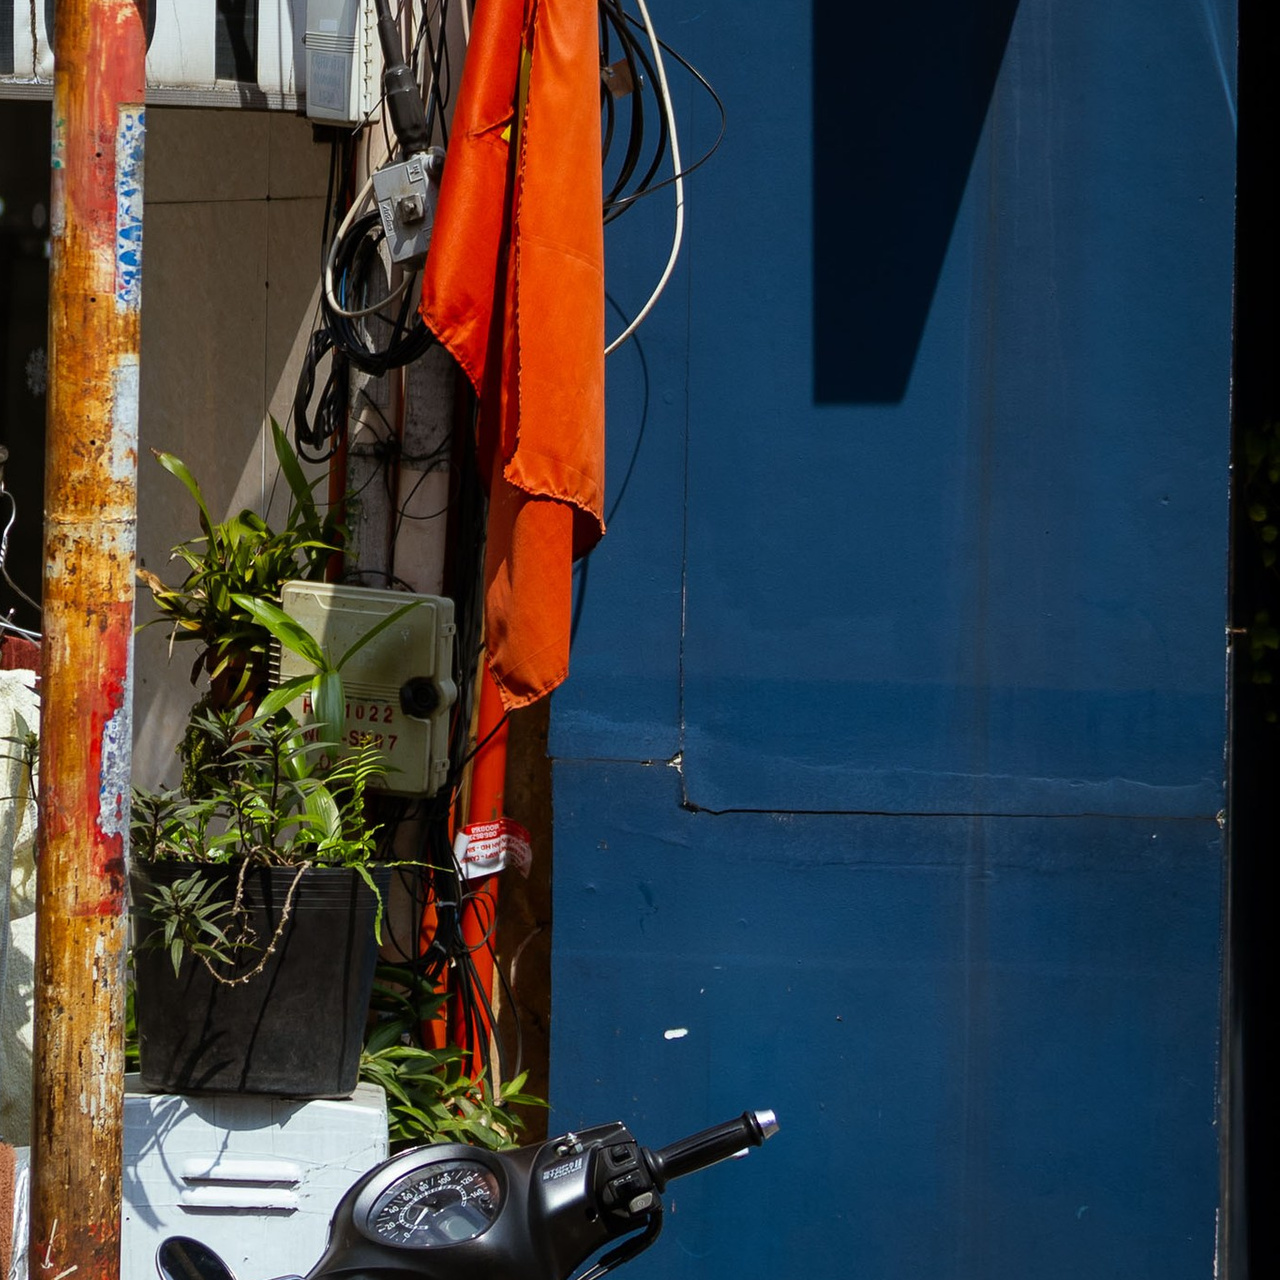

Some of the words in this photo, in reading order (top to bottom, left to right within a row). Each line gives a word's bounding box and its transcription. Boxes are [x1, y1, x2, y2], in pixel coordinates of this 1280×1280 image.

[437, 1175, 451, 1186] 100
[460, 1175, 473, 1186] 120
[418, 1183, 429, 1192] 80
[402, 1192, 413, 1201] 60
[470, 1188, 484, 1199] 140
[388, 1205, 399, 1214] 40
[385, 1221, 396, 1231] 20
